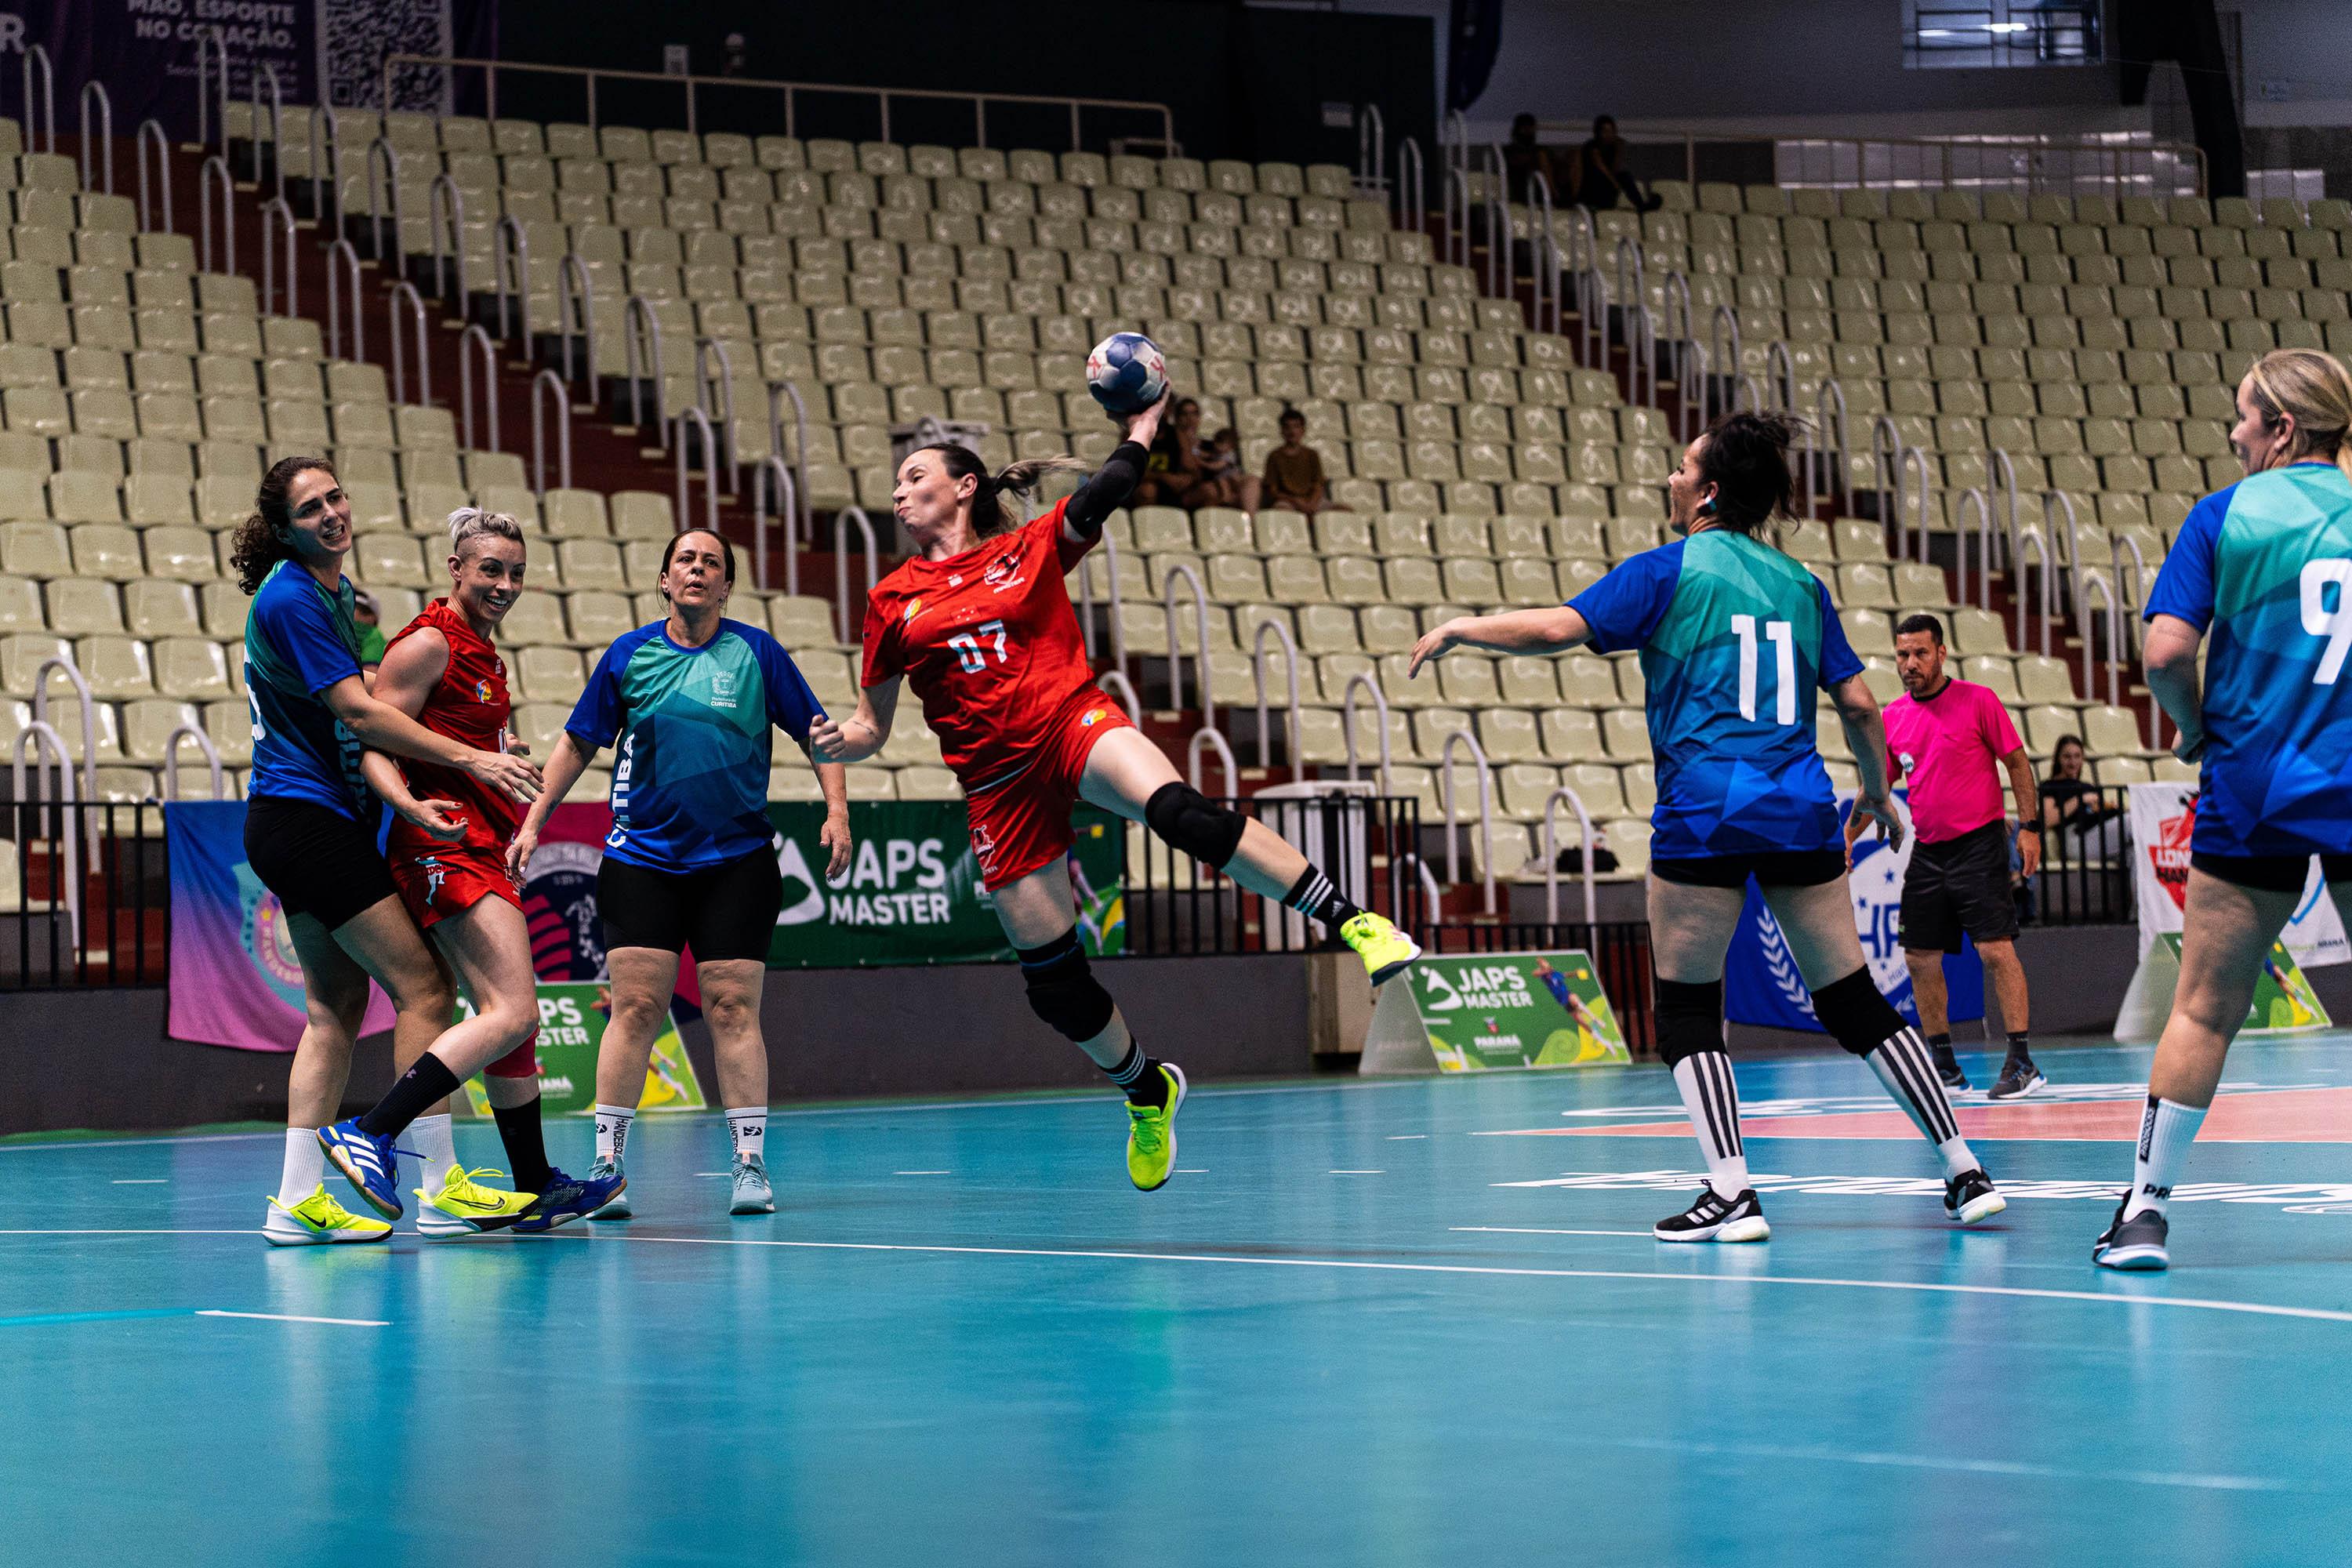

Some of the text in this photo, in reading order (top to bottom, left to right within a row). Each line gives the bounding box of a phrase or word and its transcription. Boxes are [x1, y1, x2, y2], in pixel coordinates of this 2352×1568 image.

[195, 1, 296, 24] ESPORTE
[136, 17, 171, 38] NO
[2299, 557, 2352, 684] 9
[947, 619, 1008, 674] 07
[1731, 614, 1796, 725] 11
[828, 894, 951, 926] MASTER
[1458, 966, 1526, 992] JAPS
[538, 997, 583, 1026] PS
[1463, 990, 1534, 1009] MASTER
[535, 1026, 590, 1047] STER
